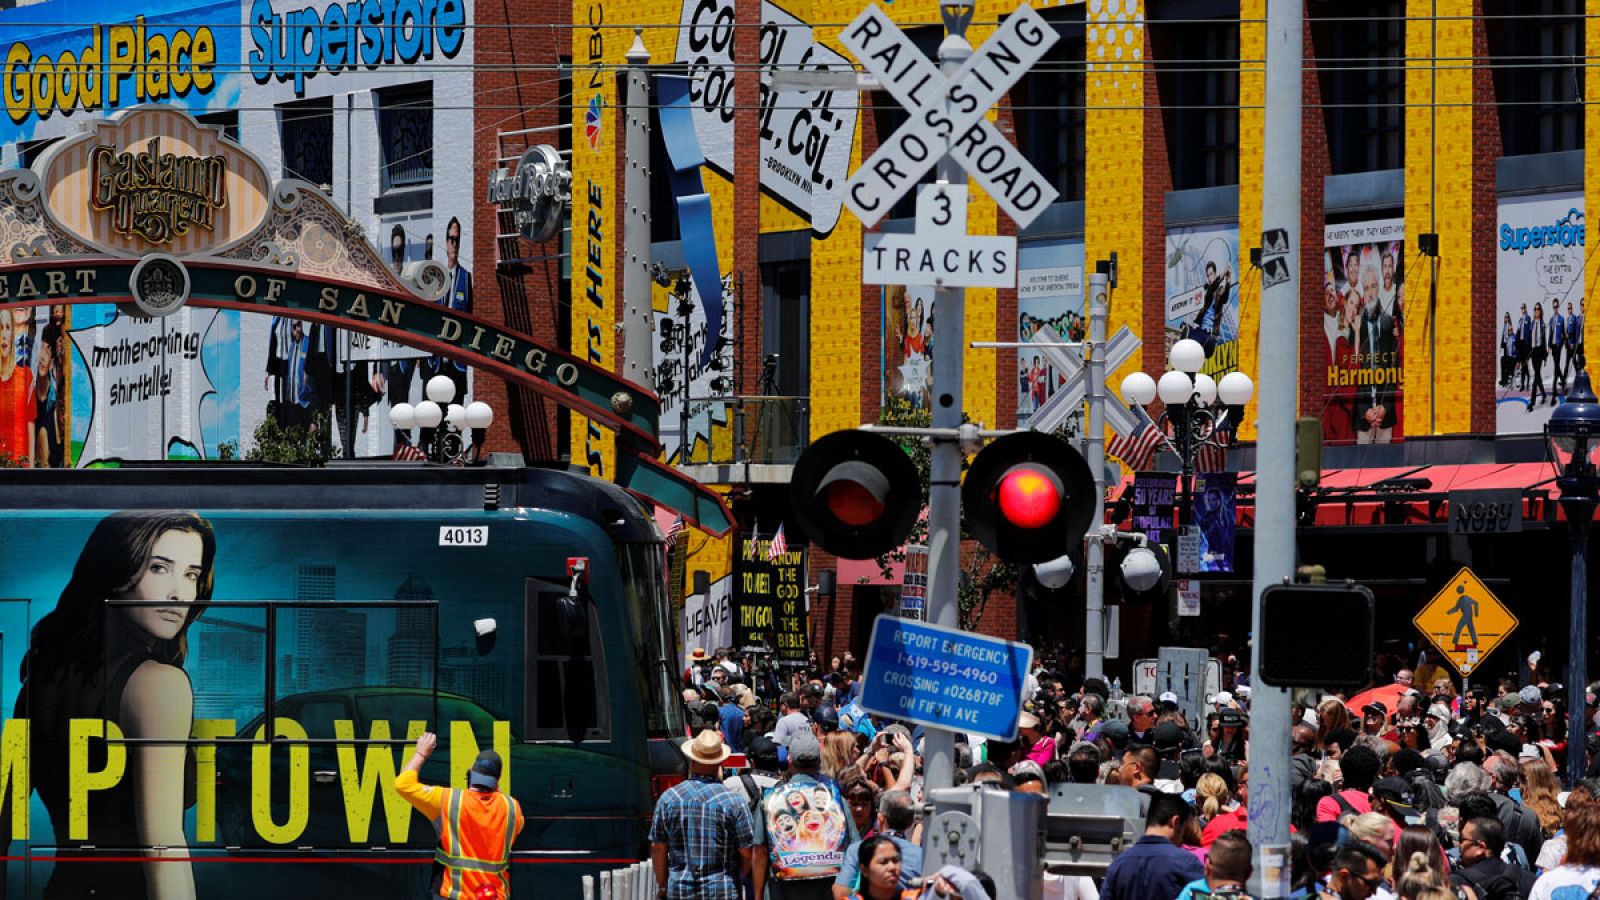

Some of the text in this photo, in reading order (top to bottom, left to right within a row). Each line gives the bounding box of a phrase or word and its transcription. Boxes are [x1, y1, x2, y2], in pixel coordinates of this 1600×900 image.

[588, 3, 604, 89] NBC
[3, 15, 217, 124] Good Place
[851, 15, 1042, 212] RAIL ROAD
[851, 17, 1044, 212] CROSSING
[89, 137, 227, 211] Gaslamp
[931, 192, 952, 226] 3
[587, 179, 604, 310] HERE
[872, 247, 1008, 275] TRACKS
[234, 275, 286, 301] OF
[319, 287, 405, 325] SAN
[437, 316, 579, 386] DIEGO
[1342, 351, 1397, 364] PERFECT
[444, 527, 483, 545] 4013
[778, 568, 797, 582] THE
[776, 584, 799, 599] GOD
[783, 601, 796, 615] OF
[781, 617, 800, 632] THE
[777, 633, 805, 648] BIBLE
[893, 630, 1009, 666] REPORT EMERGENCY
[883, 670, 940, 694] CROSSING
[897, 652, 998, 685] 1-619-595-4960
[900, 695, 980, 723] ON FIFTH AVE
[783, 850, 842, 866] Legends
